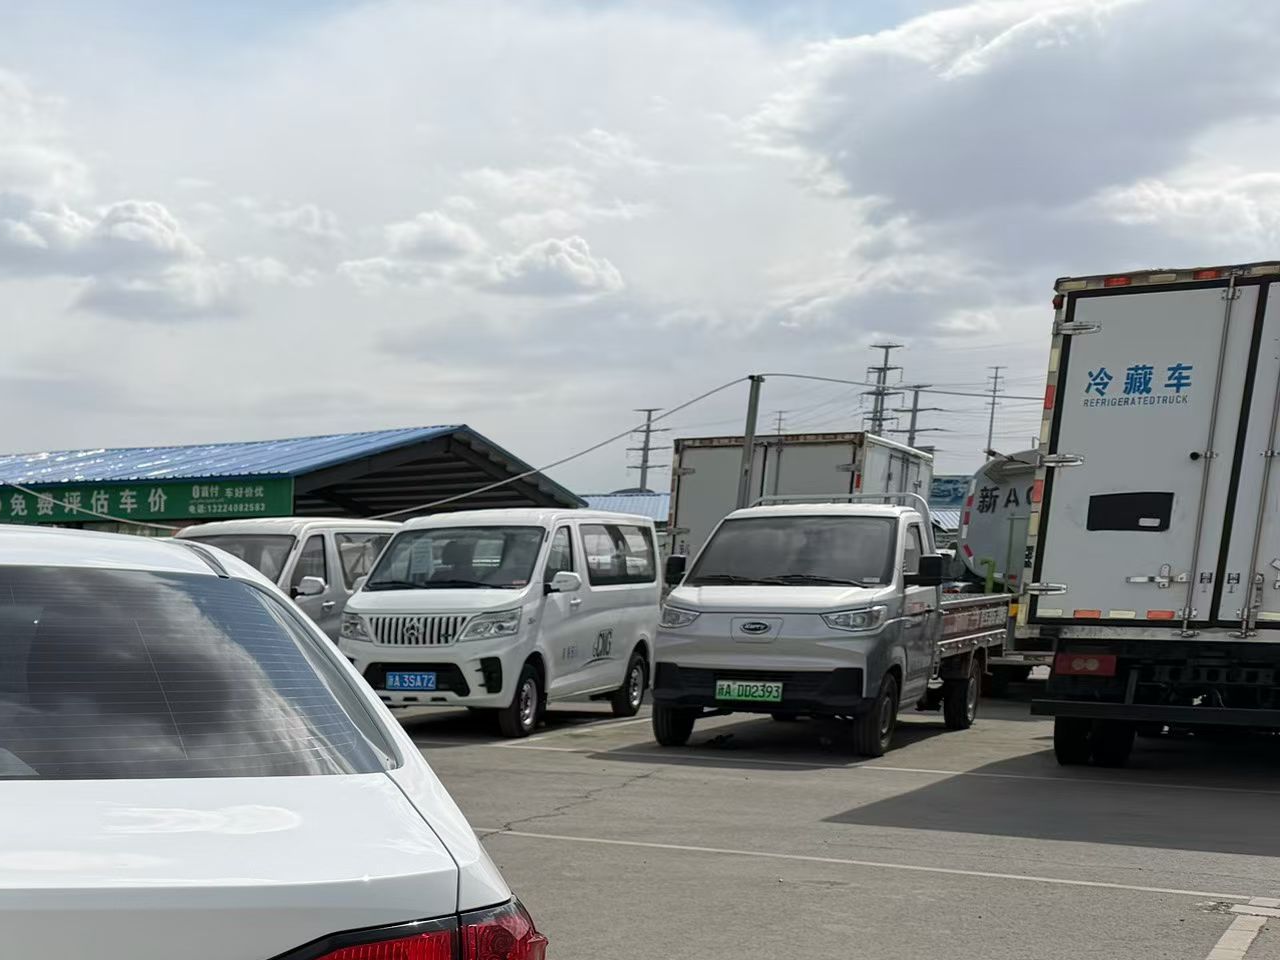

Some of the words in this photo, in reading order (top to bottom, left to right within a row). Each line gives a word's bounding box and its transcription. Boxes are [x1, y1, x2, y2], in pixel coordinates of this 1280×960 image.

[1084, 363, 1193, 396] 冷藏车
[1083, 395, 1188, 407] REFRIGERATEDTRUCK
